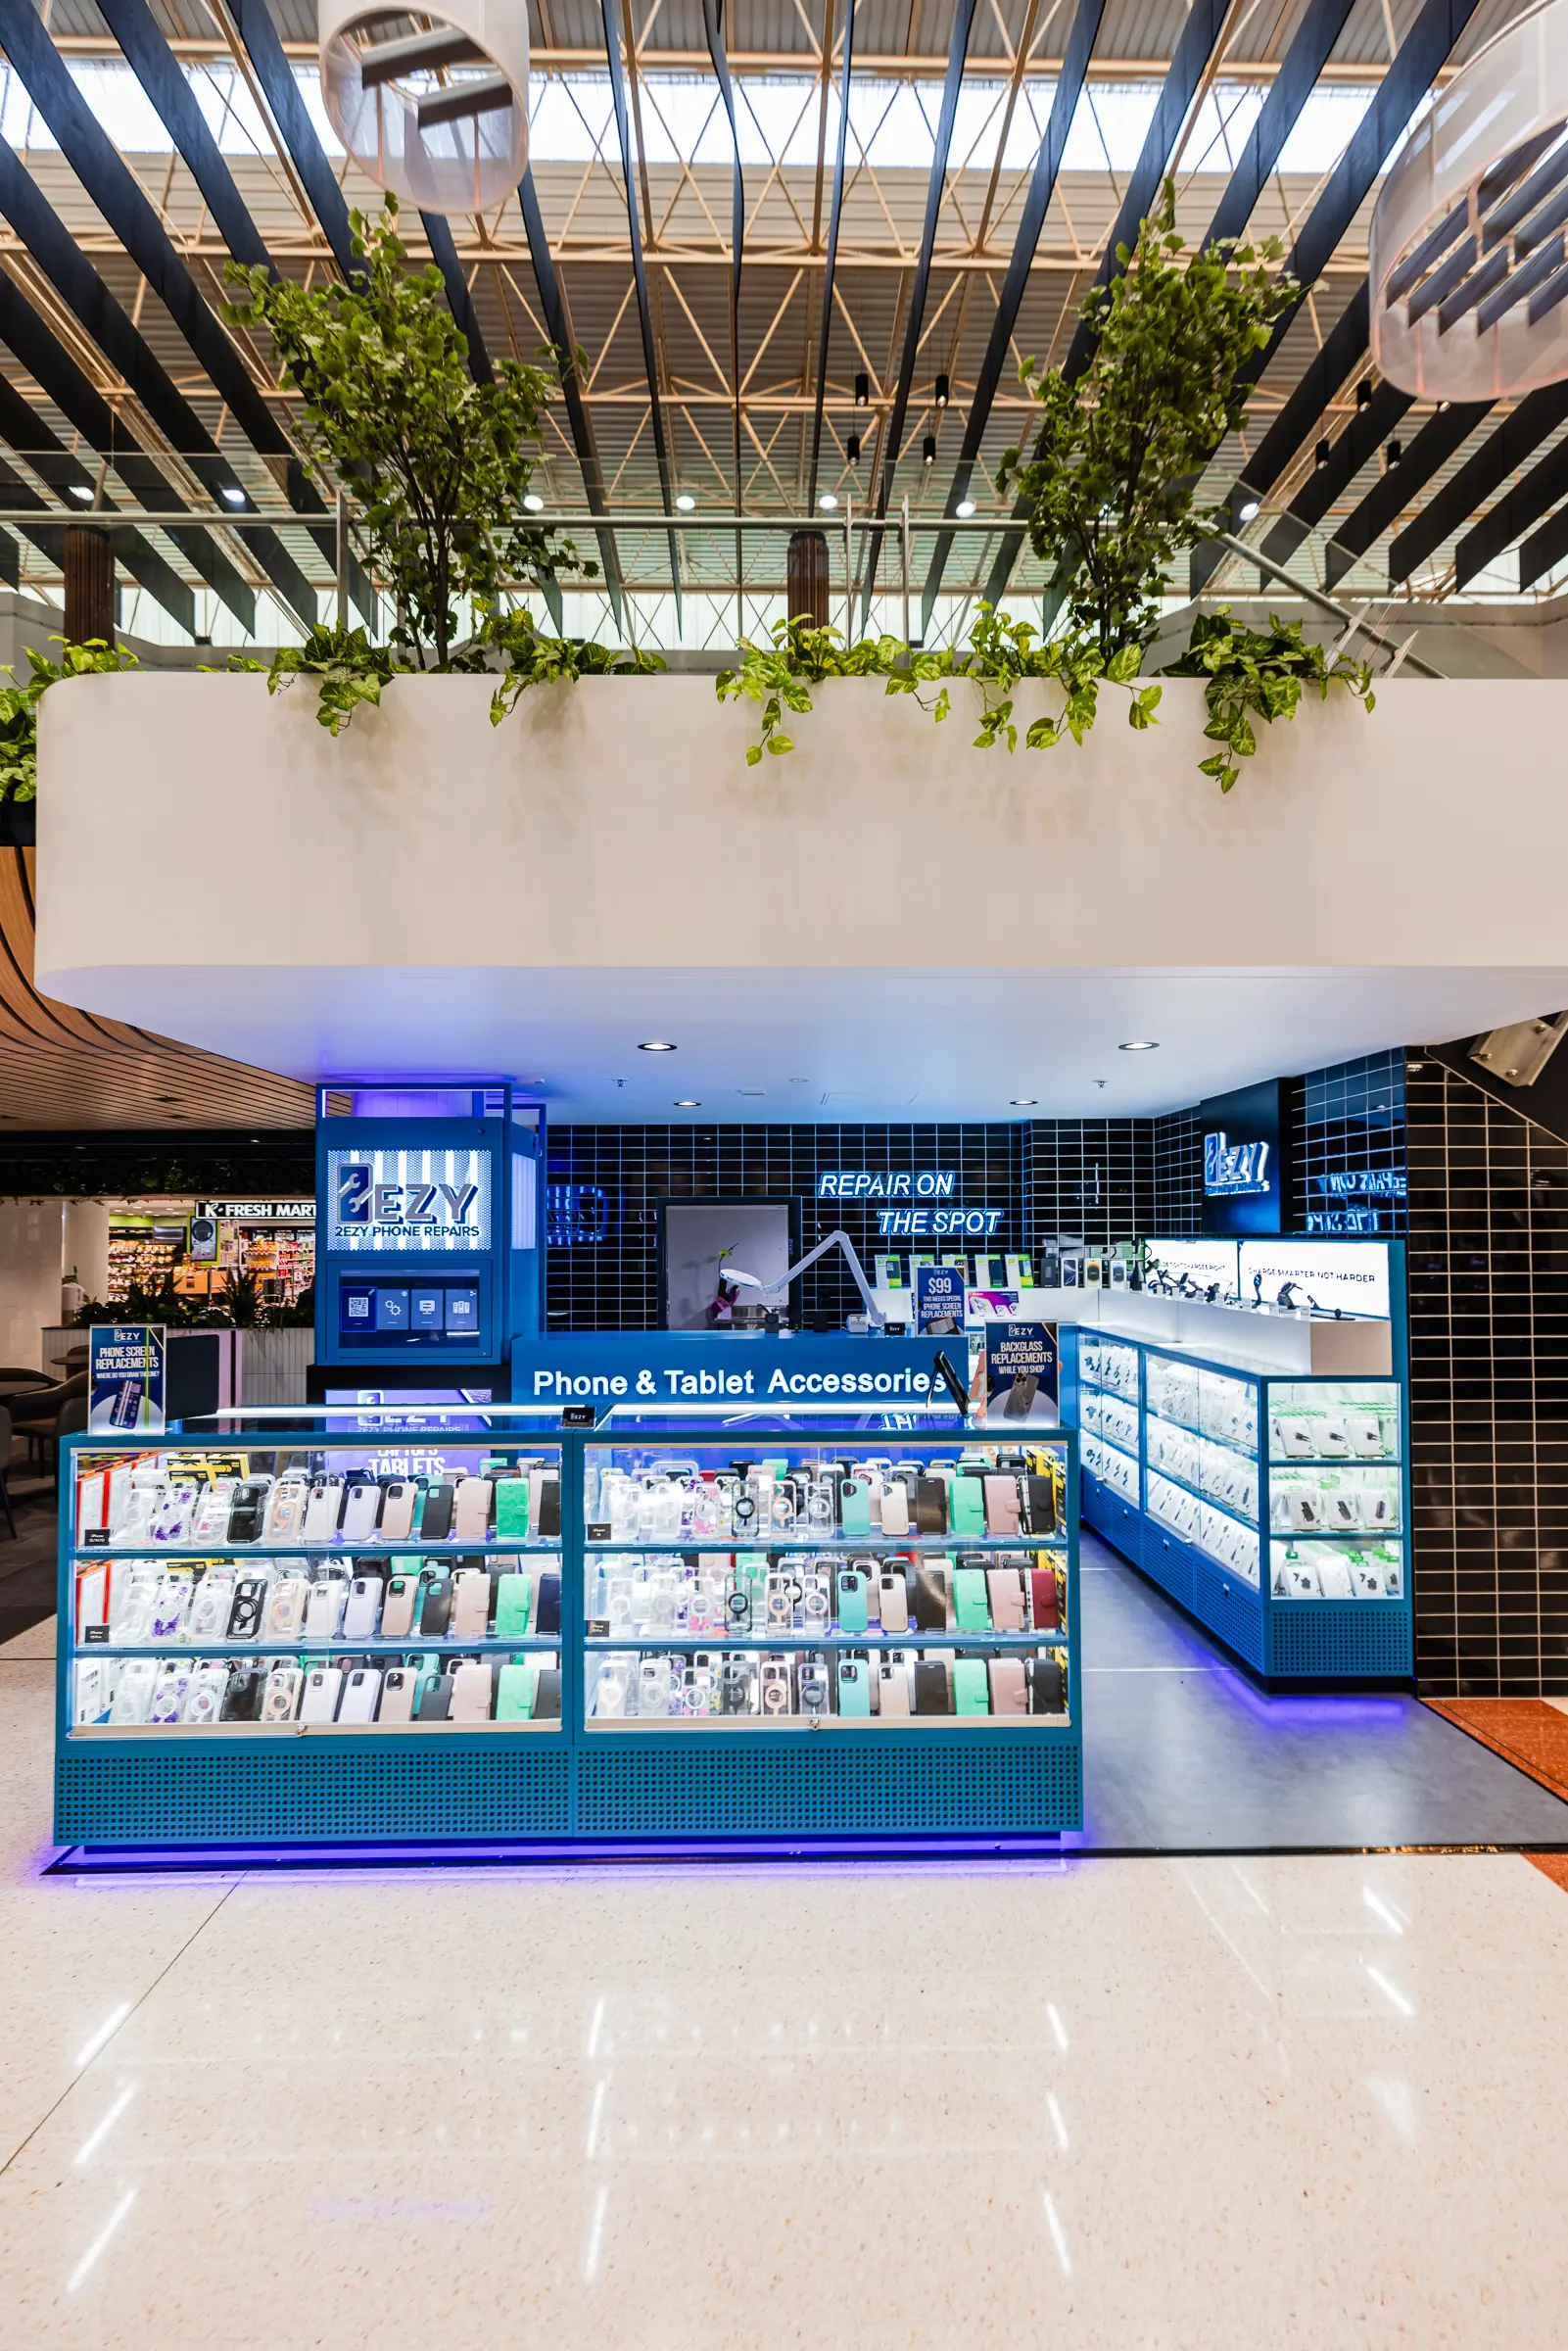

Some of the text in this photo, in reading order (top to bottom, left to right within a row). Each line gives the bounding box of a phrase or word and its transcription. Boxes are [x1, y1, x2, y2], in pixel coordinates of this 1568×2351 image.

[820, 1174, 954, 1196] REPAIR ON
[276, 1204, 316, 1217] MART
[879, 1211, 1002, 1233] THE SPOT
[335, 1226, 480, 1237] 2EZY PHONE REPAIRS
[1277, 1269, 1314, 1277] SMARTER
[1317, 1271, 1334, 1279] NOT
[1336, 1272, 1375, 1283] HARDER
[927, 1276, 952, 1294] $99
[921, 1310, 964, 1319] REPLACEMENTS
[99, 1347, 125, 1358] PHONE
[1000, 1341, 1043, 1353] BACKGLASS
[95, 1357, 160, 1370] REPLACEMENTS
[991, 1352, 1053, 1365] REPLACEMENTS
[998, 1366, 1017, 1374] WHILE
[1029, 1365, 1045, 1373] SHOP
[533, 1367, 947, 1396] Phone & Tablet Accessories
[368, 1457, 446, 1477] TABLETS
